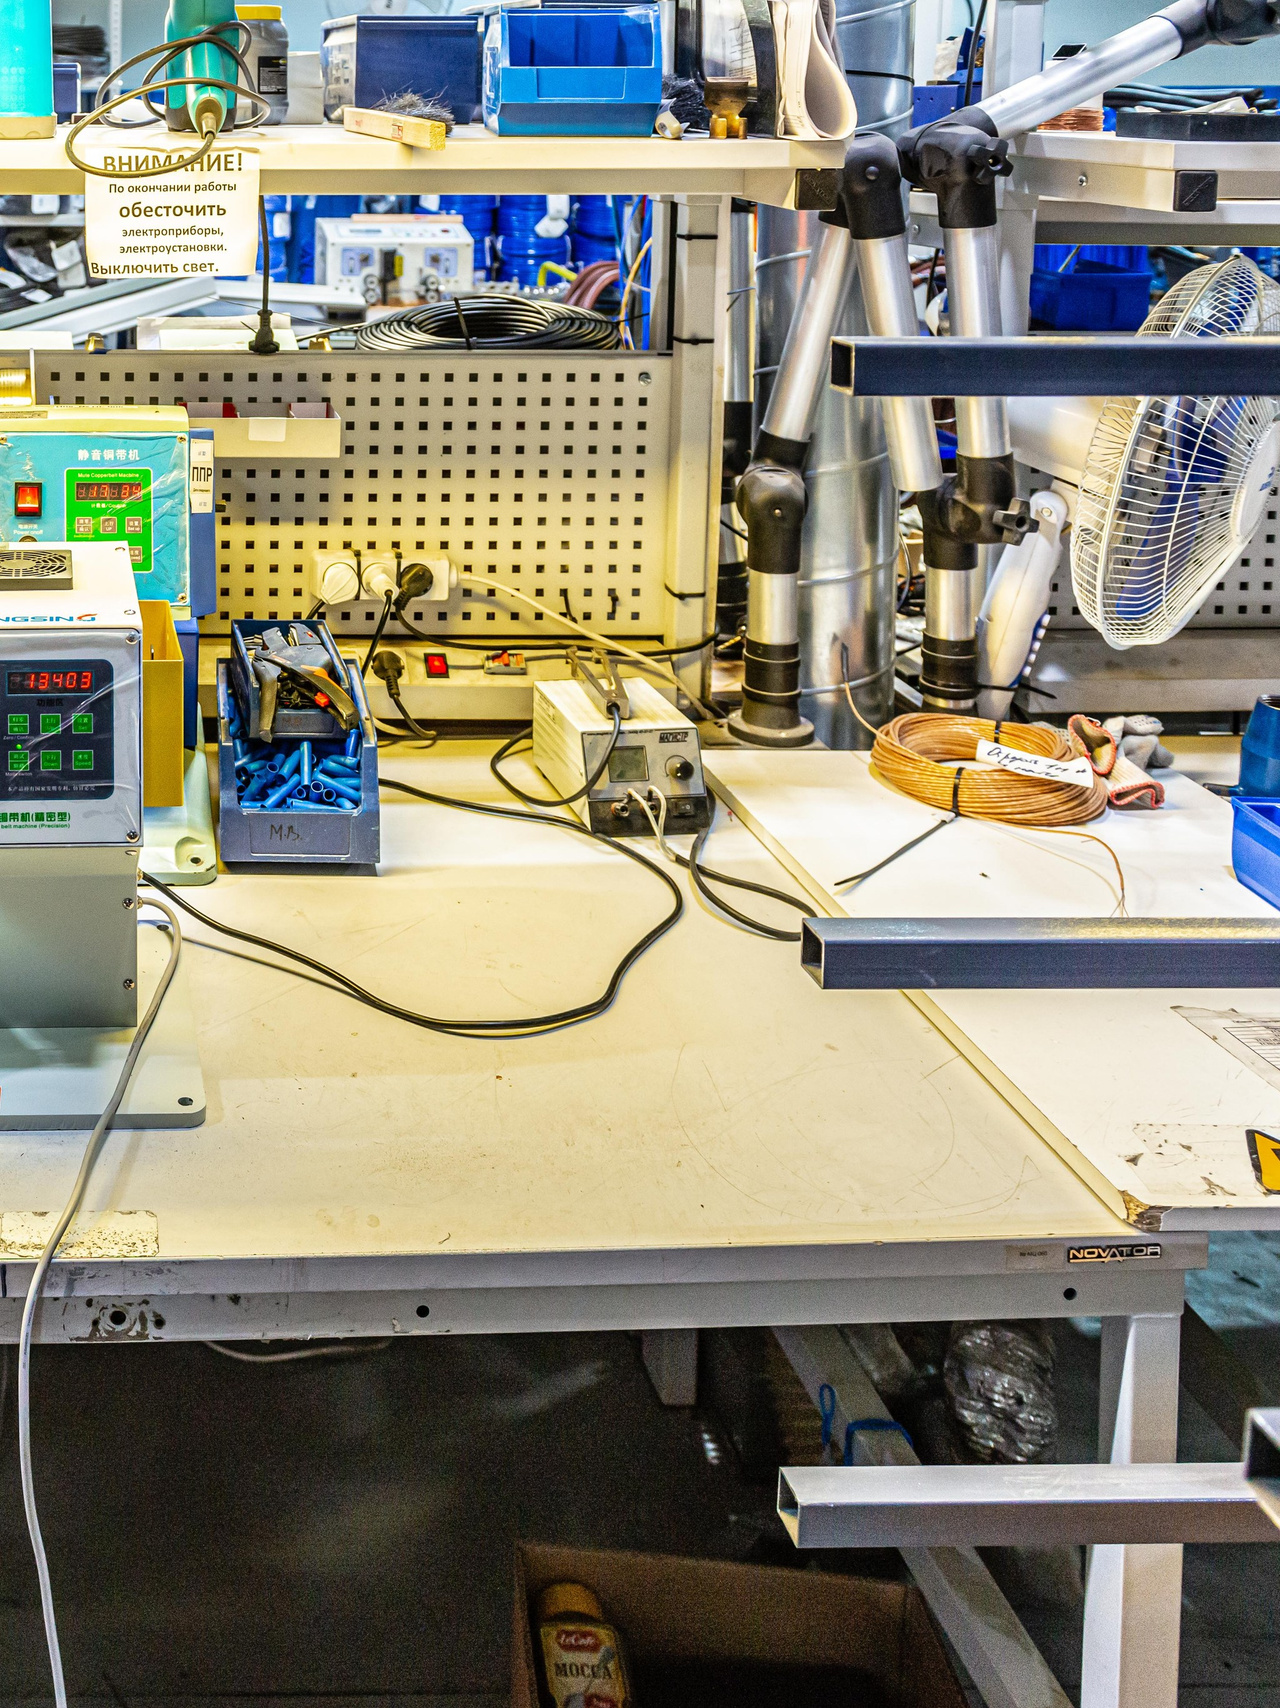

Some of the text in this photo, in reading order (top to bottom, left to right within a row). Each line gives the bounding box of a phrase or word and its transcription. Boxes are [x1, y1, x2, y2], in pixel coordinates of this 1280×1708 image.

[109, 182, 237, 194] По окончании работы
[119, 202, 227, 218] обесточить
[122, 226, 224, 239] электроприборы,
[119, 244, 227, 255] электроустановки.
[90, 262, 219, 275] Выключить свет.
[78, 449, 139, 461] 静音铜带机
[192, 466, 213, 482] ППР
[29, 672, 92, 689] 13403
[1070, 1246, 1161, 1263] NOVATOR
